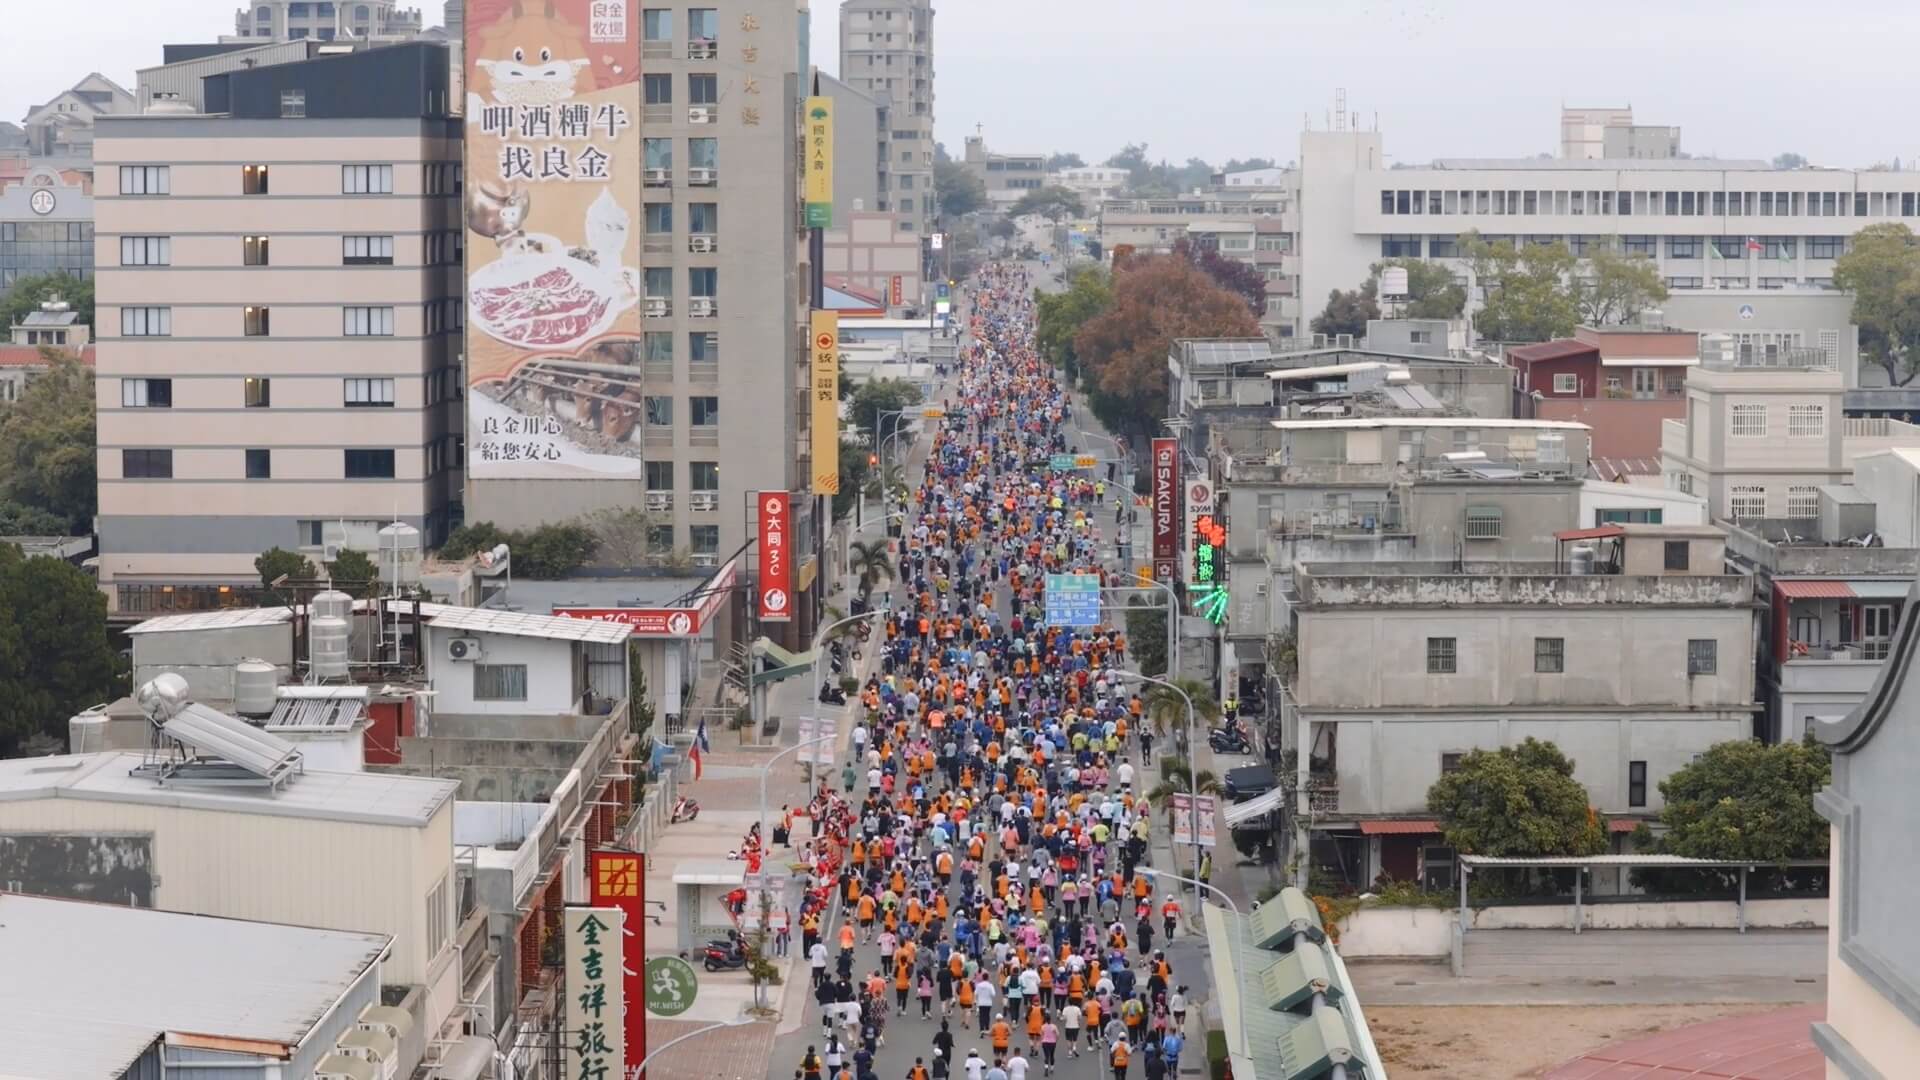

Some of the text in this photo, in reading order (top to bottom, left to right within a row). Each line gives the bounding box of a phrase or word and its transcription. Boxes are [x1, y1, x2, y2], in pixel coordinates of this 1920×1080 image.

[483, 104, 627, 137] 呷酒糟牛
[502, 146, 608, 179] 找良金
[483, 416, 562, 434] 良金用心
[481, 442, 561, 460] 給您安心
[1158, 468, 1171, 535] SAKURA
[1190, 505, 1211, 513] SYM
[767, 516, 781, 576] 大同3C
